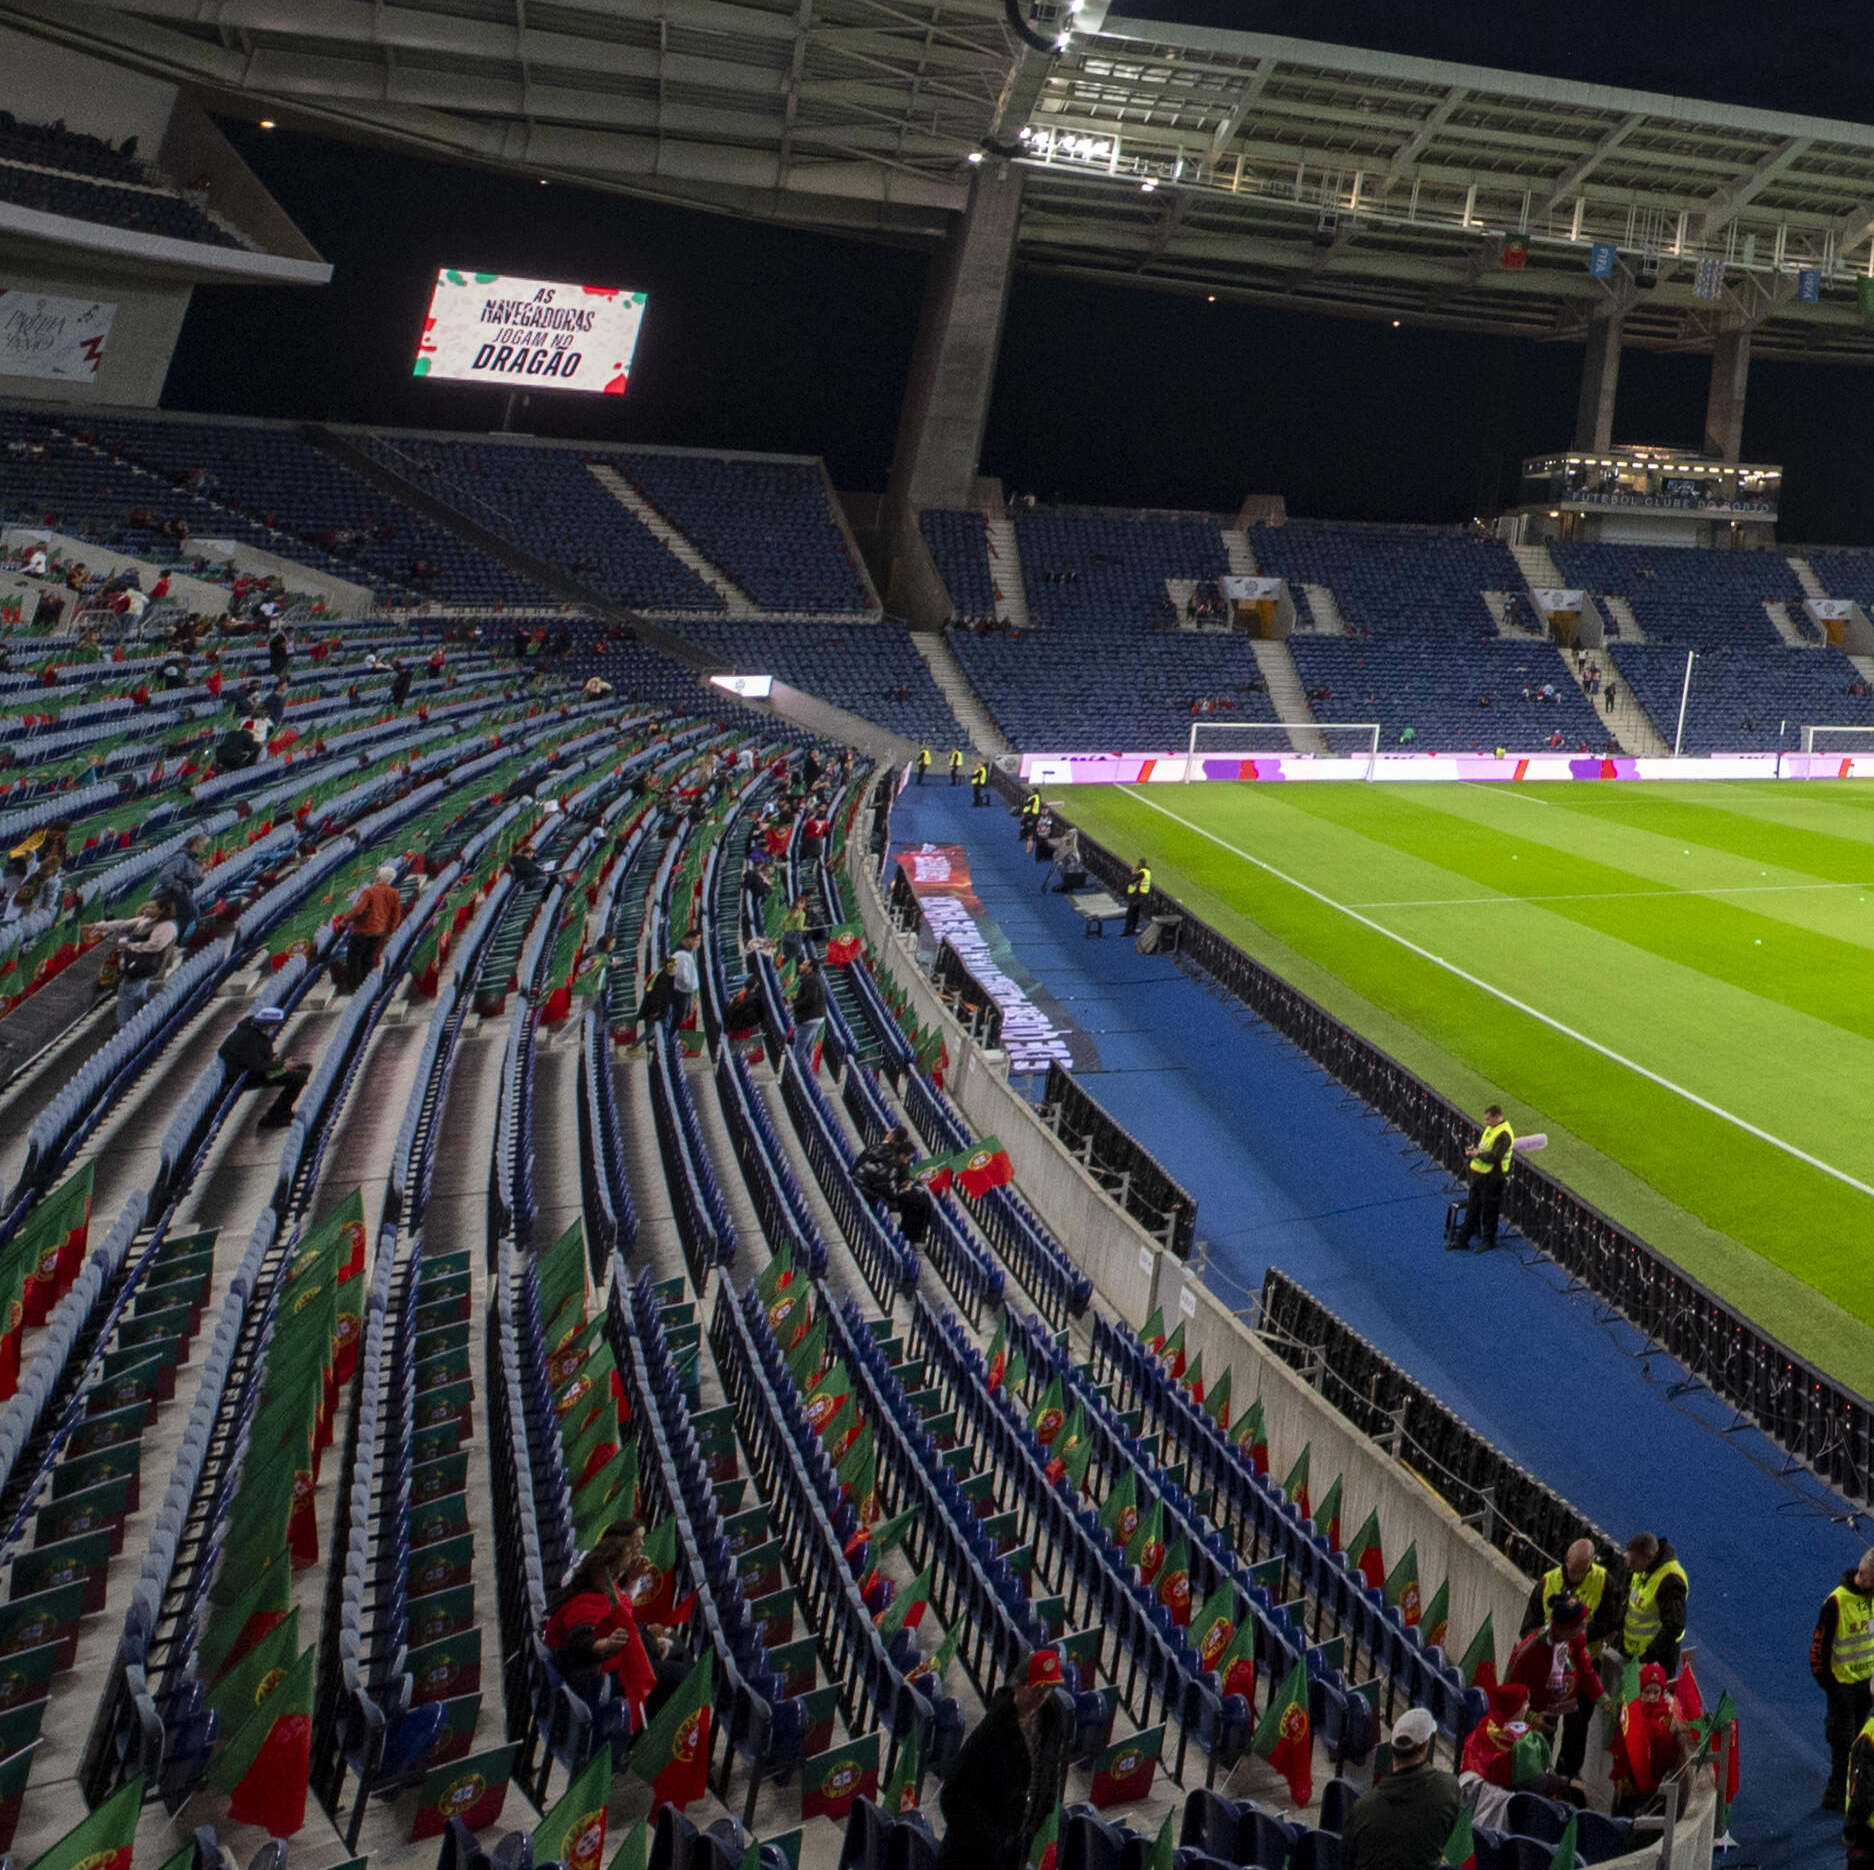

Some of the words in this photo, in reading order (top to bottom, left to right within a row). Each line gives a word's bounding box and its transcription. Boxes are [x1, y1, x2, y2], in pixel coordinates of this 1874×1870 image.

[533, 288, 556, 304] AS
[481, 299, 596, 332] NAVEGADORAS
[492, 329, 546, 347] JOGAM
[551, 333, 574, 347] NO
[472, 344, 582, 378] DRAGÃO
[1572, 492, 1637, 508] FUTEBOL
[1644, 497, 1690, 509] CLUBE
